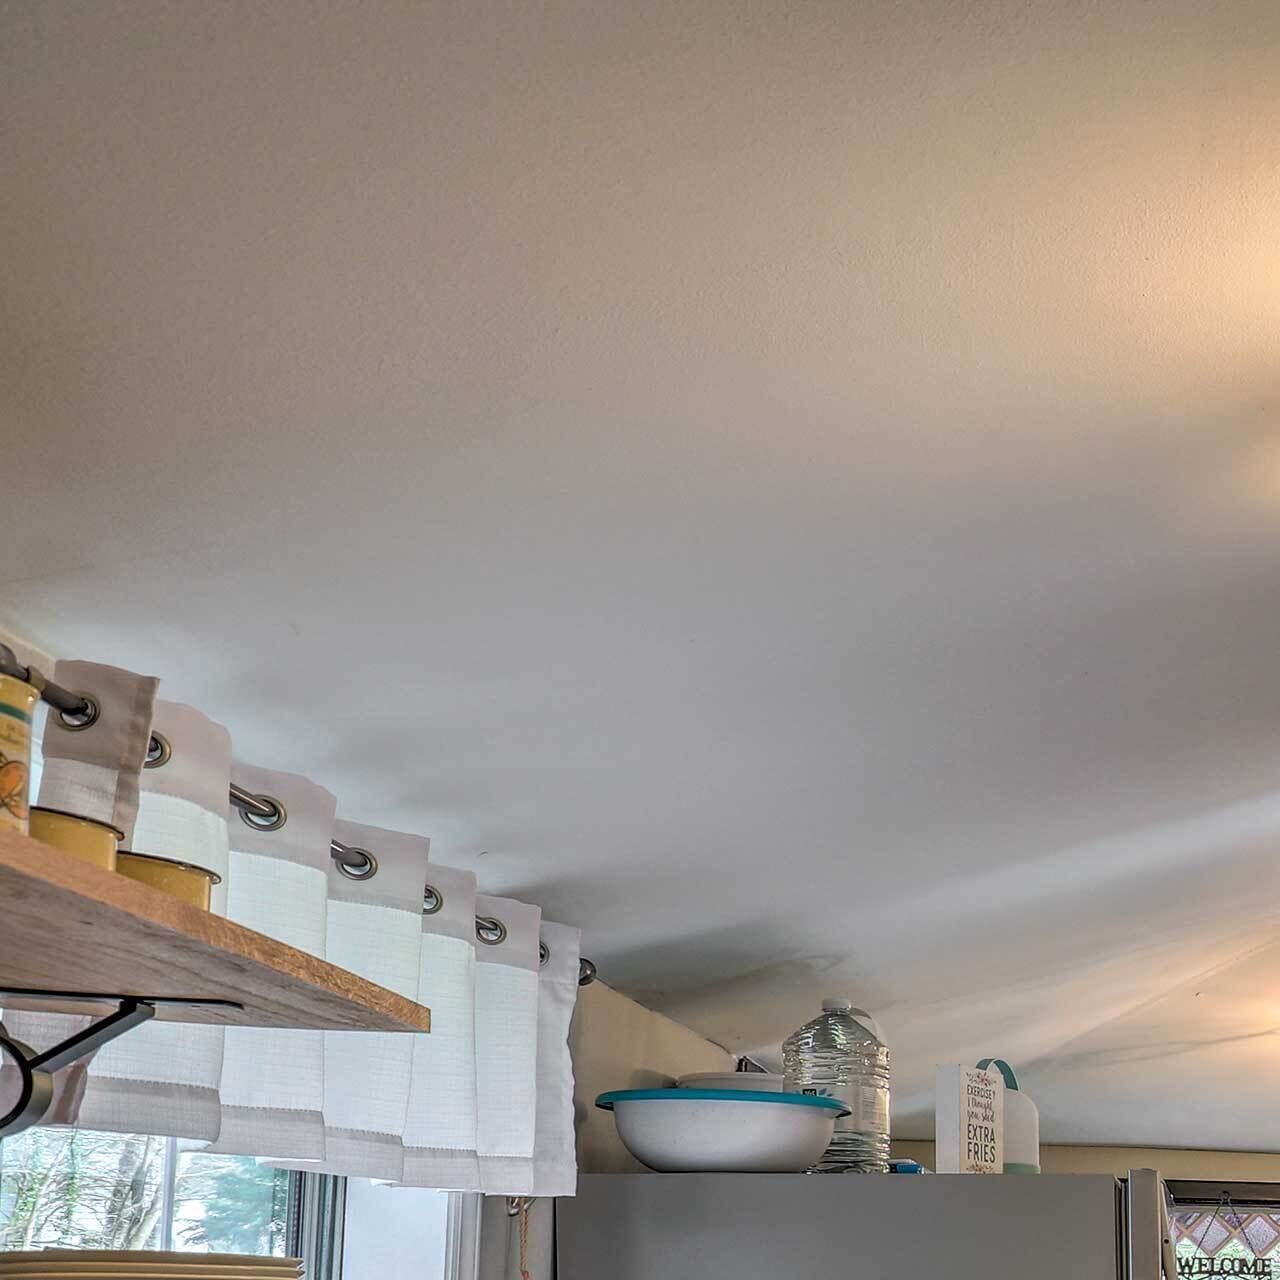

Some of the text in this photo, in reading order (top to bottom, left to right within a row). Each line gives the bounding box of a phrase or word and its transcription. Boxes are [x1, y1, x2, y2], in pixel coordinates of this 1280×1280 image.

[967, 1123, 996, 1144] EXTRA
[967, 1141, 996, 1164] FRIES
[1176, 1257, 1272, 1276] WELCOME
